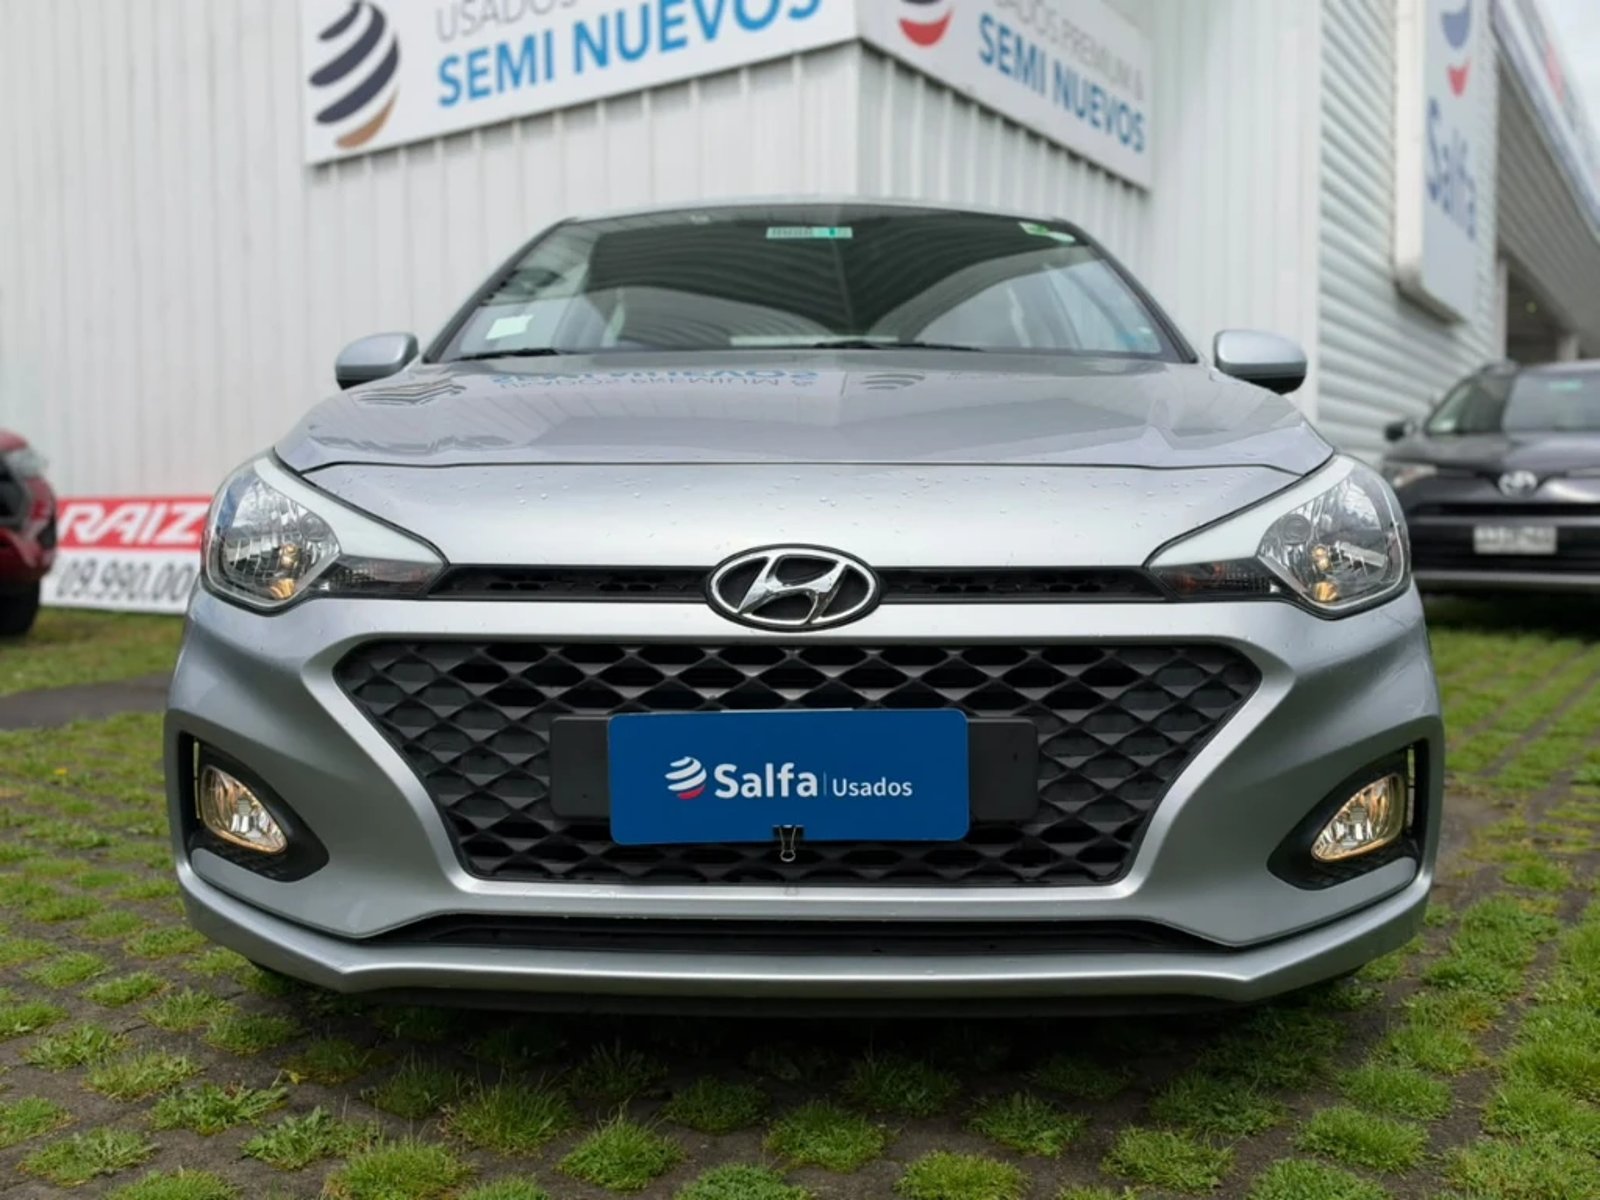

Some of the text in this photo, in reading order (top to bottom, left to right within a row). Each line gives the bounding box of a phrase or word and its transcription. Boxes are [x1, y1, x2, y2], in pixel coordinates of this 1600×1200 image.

[436, 0, 577, 42] USAD
[437, 29, 553, 107] SEMI
[979, 12, 1145, 153] SEMI NUEVOS
[1426, 96, 1476, 242] Salfa
[714, 762, 913, 798] Salfa Usados
